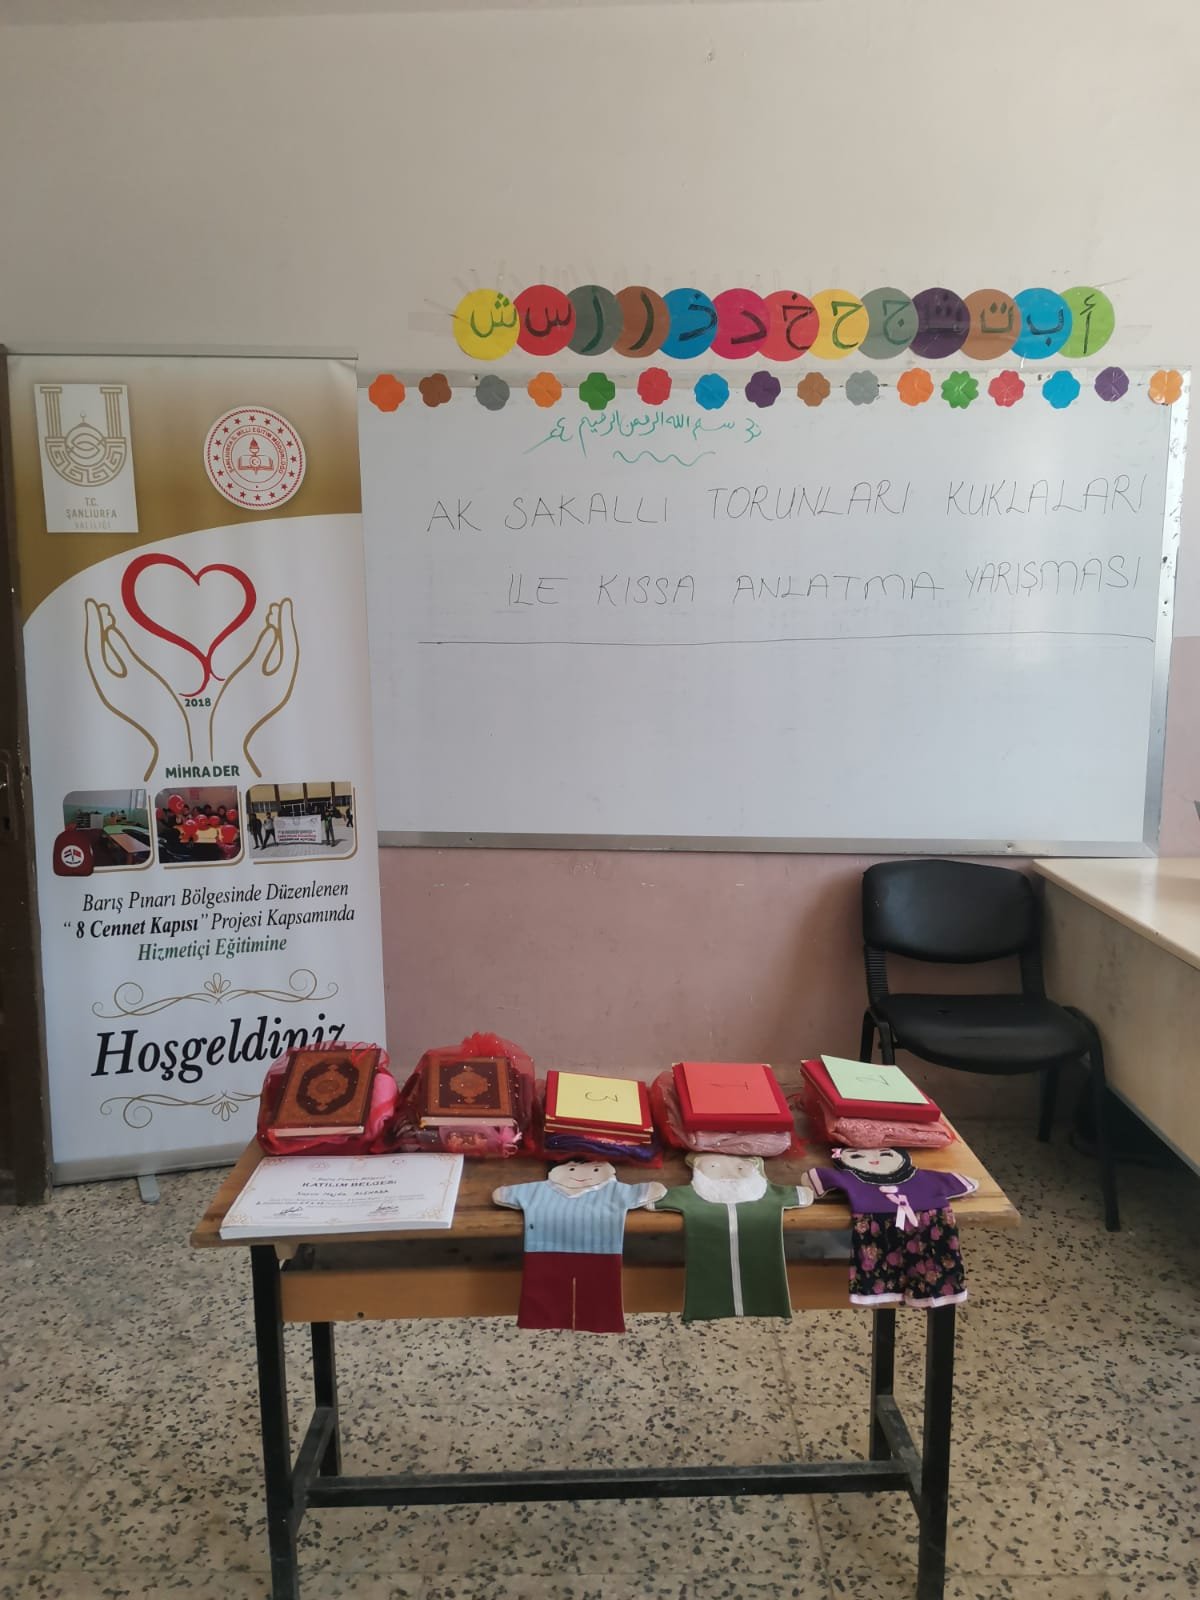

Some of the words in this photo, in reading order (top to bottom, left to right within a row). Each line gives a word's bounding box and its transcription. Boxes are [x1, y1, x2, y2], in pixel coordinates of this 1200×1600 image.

[470, 292, 517, 338] ش
[524, 302, 571, 338] س
[730, 309, 768, 345] د
[782, 292, 816, 351] خ
[831, 300, 863, 350] ح
[882, 299, 913, 347] ج
[980, 301, 1013, 334] ت
[1026, 306, 1064, 347] ب
[427, 498, 482, 532] AK
[504, 492, 668, 530] SAKALLI
[706, 479, 911, 521] TORUNLARI
[946, 474, 1148, 516] KUKLALARI
[597, 575, 694, 607] KISSA
[732, 571, 945, 605] ANLATMA
[964, 554, 1141, 598] YARIŞMASI
[185, 698, 211, 707] 2018
[82, 893, 123, 914] Barış
[128, 891, 176, 909] Pınarı
[181, 883, 262, 909] Bölgesinde
[266, 880, 349, 901] Düzenlenen
[90, 918, 146, 938] Cennet
[211, 910, 262, 933] Projesi
[267, 903, 355, 930] Kapsamında
[138, 939, 210, 961] Hizmetiçi
[215, 934, 287, 959] Eğitimine
